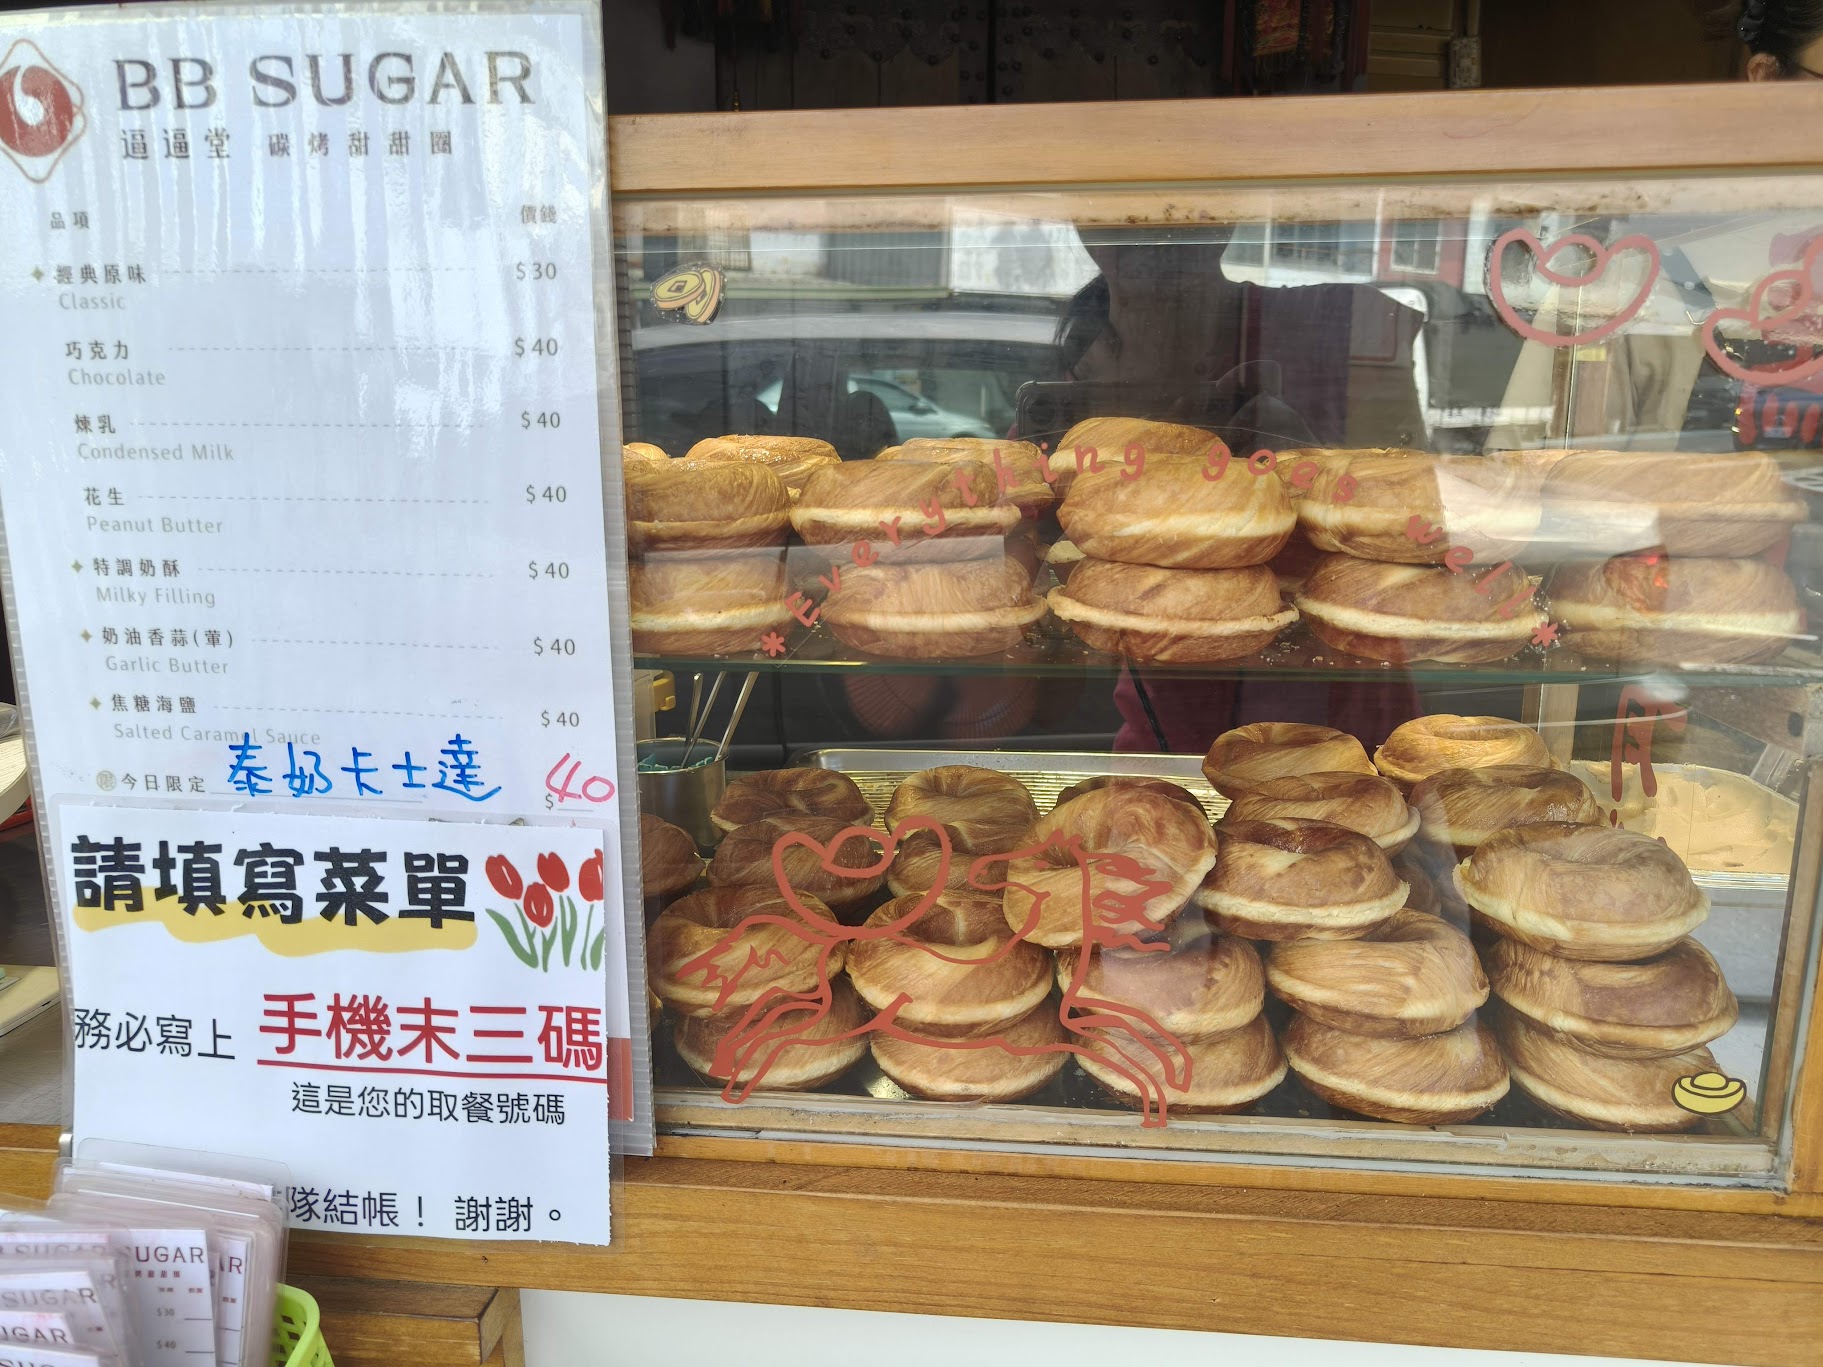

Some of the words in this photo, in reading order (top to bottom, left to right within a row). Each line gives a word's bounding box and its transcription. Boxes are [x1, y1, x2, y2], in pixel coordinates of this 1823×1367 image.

[114, 57, 218, 111] BB
[250, 50, 537, 108] SUGAR
[120, 127, 231, 160] 逼逼堂
[268, 130, 453, 157] 碳烤甜甜圈
[50, 211, 91, 230] 品項
[519, 203, 558, 225] 價錢
[54, 263, 147, 285] 經典原味
[515, 261, 558, 281] $30
[58, 292, 127, 310] Classic
[65, 340, 130, 360] 巧克力
[513, 337, 560, 359] $40
[67, 368, 167, 386] Chocolate
[74, 413, 117, 435] 煉乳
[520, 410, 562, 430] $40
[77, 443, 184, 461] Condensed
[192, 444, 236, 462] Milk
[83, 486, 126, 507] 花生
[525, 483, 568, 505] $40
[86, 515, 154, 534] Peanut
[161, 516, 224, 535] Butter
[785, 442, 1146, 629] Everything
[1201, 443, 1359, 502] goes
[1405, 513, 1537, 620] well
[93, 557, 181, 578] 特調奶酥
[527, 559, 571, 581] $40
[95, 586, 147, 606] Milky
[154, 587, 216, 609] Filling
[102, 626, 234, 649] 奶油香蒜(葷)
[533, 635, 577, 658] $40
[105, 655, 162, 673] Garlic
[168, 657, 229, 674] Butter
[111, 693, 198, 714] 焦糖海鹽
[540, 709, 581, 728] $40
[113, 723, 173, 740] Salted
[265, 728, 321, 746] Sauce
[228, 732, 502, 803] 泰奶卡士達
[545, 752, 616, 804] 40
[120, 772, 206, 794] 今日限定
[70, 834, 476, 930] 請填寫菜單
[74, 1006, 237, 1061] 務必寫上
[257, 991, 604, 1072] 手機末三碼
[290, 1081, 567, 1126] 這是您的取餐號碼
